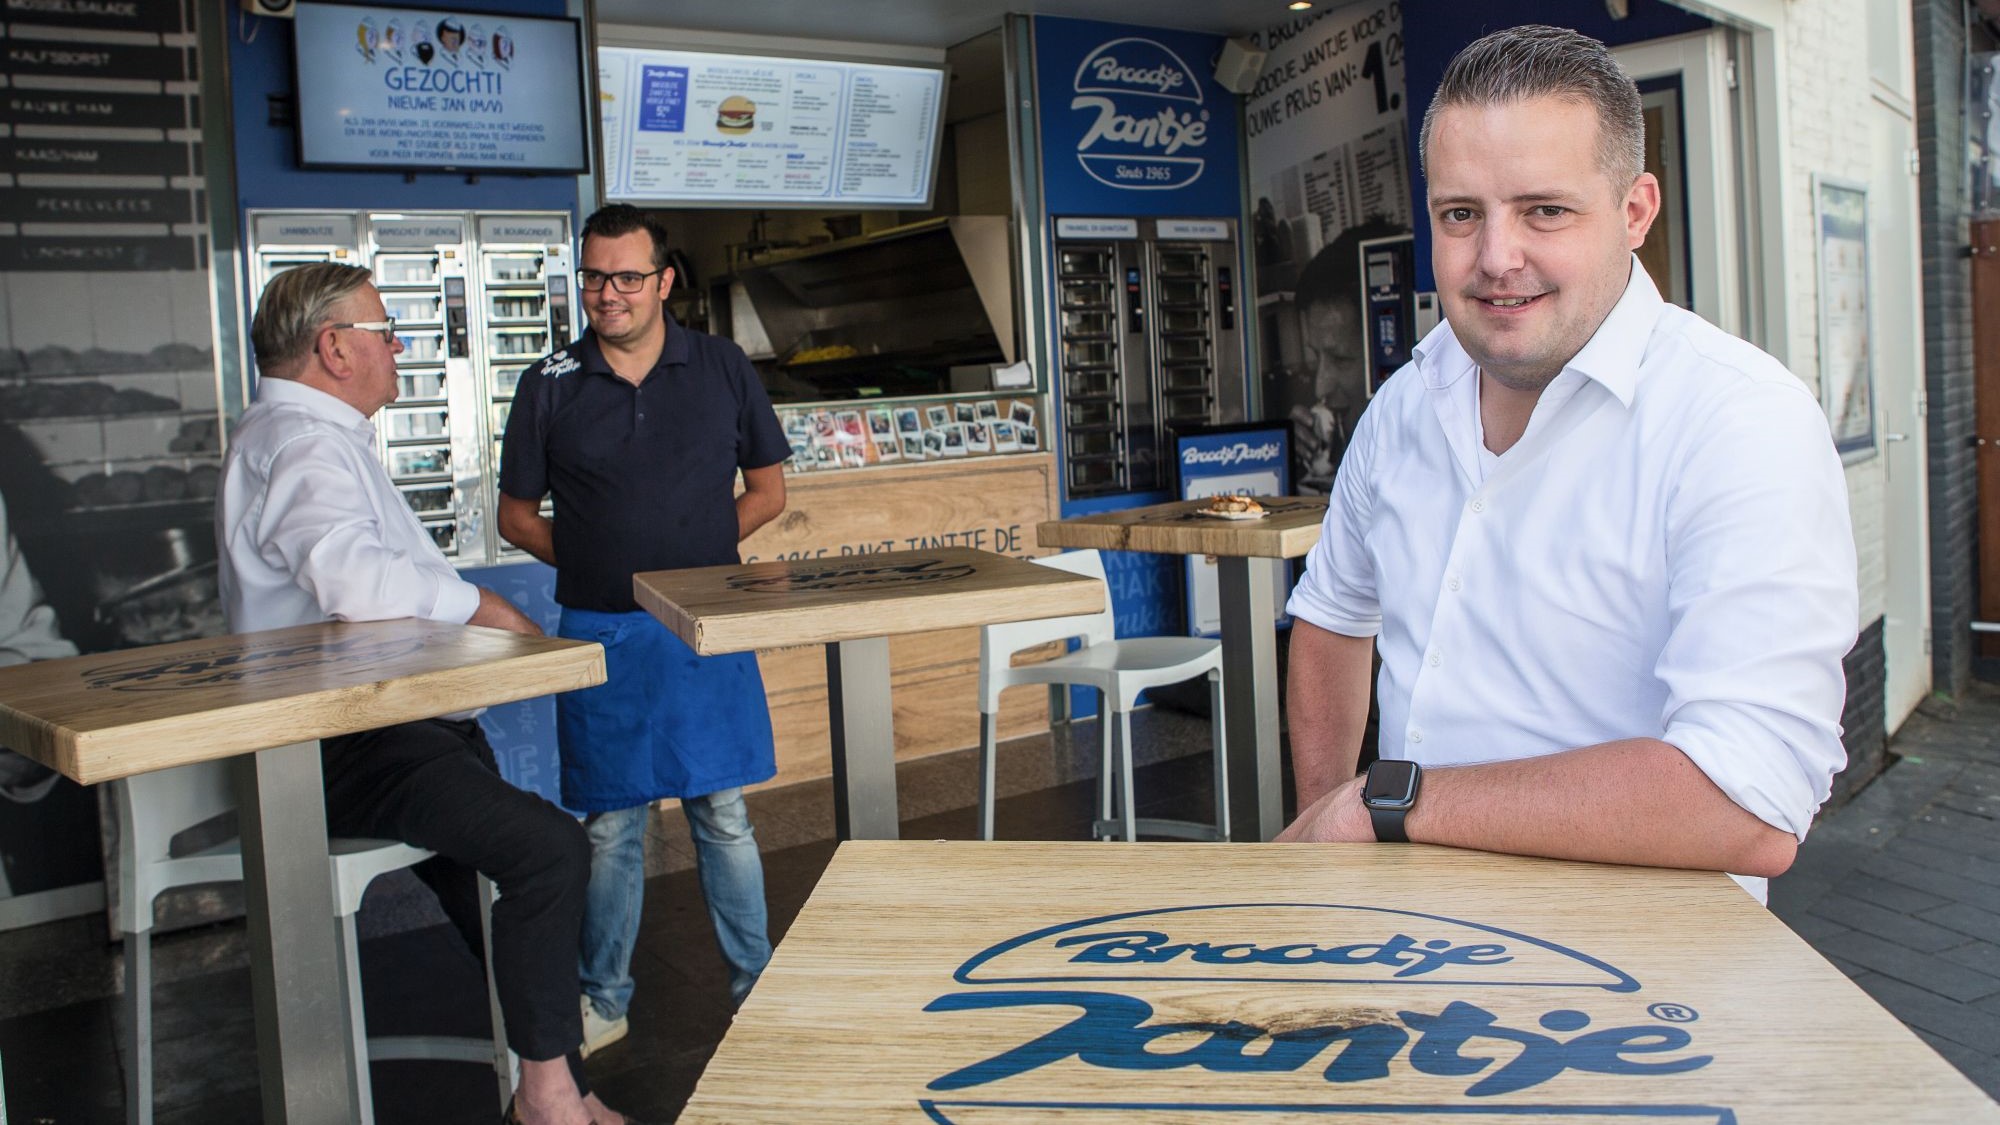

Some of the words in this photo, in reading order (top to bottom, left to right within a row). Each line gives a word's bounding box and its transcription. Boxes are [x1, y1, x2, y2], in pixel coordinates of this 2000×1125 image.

[1352, 9, 1386, 43] VOOR
[385, 67, 503, 95] GEZOCHT!
[1092, 56, 1184, 93] Broodje
[11, 101, 70, 115] RAUWE
[75, 103, 113, 115] HAM
[388, 96, 437, 112] NIEUWE
[441, 98, 465, 113] JAN
[1248, 101, 1283, 138] OUWE
[1286, 80, 1322, 118] PRIJS
[1071, 96, 1208, 155] Jantje
[1115, 164, 1144, 179] Sinds
[1146, 166, 1171, 181] 1965
[1182, 446, 1235, 466] Broodje
[996, 525, 1022, 553] DE
[1055, 930, 1514, 978] Broodje
[922, 991, 1714, 1098] Jantje
